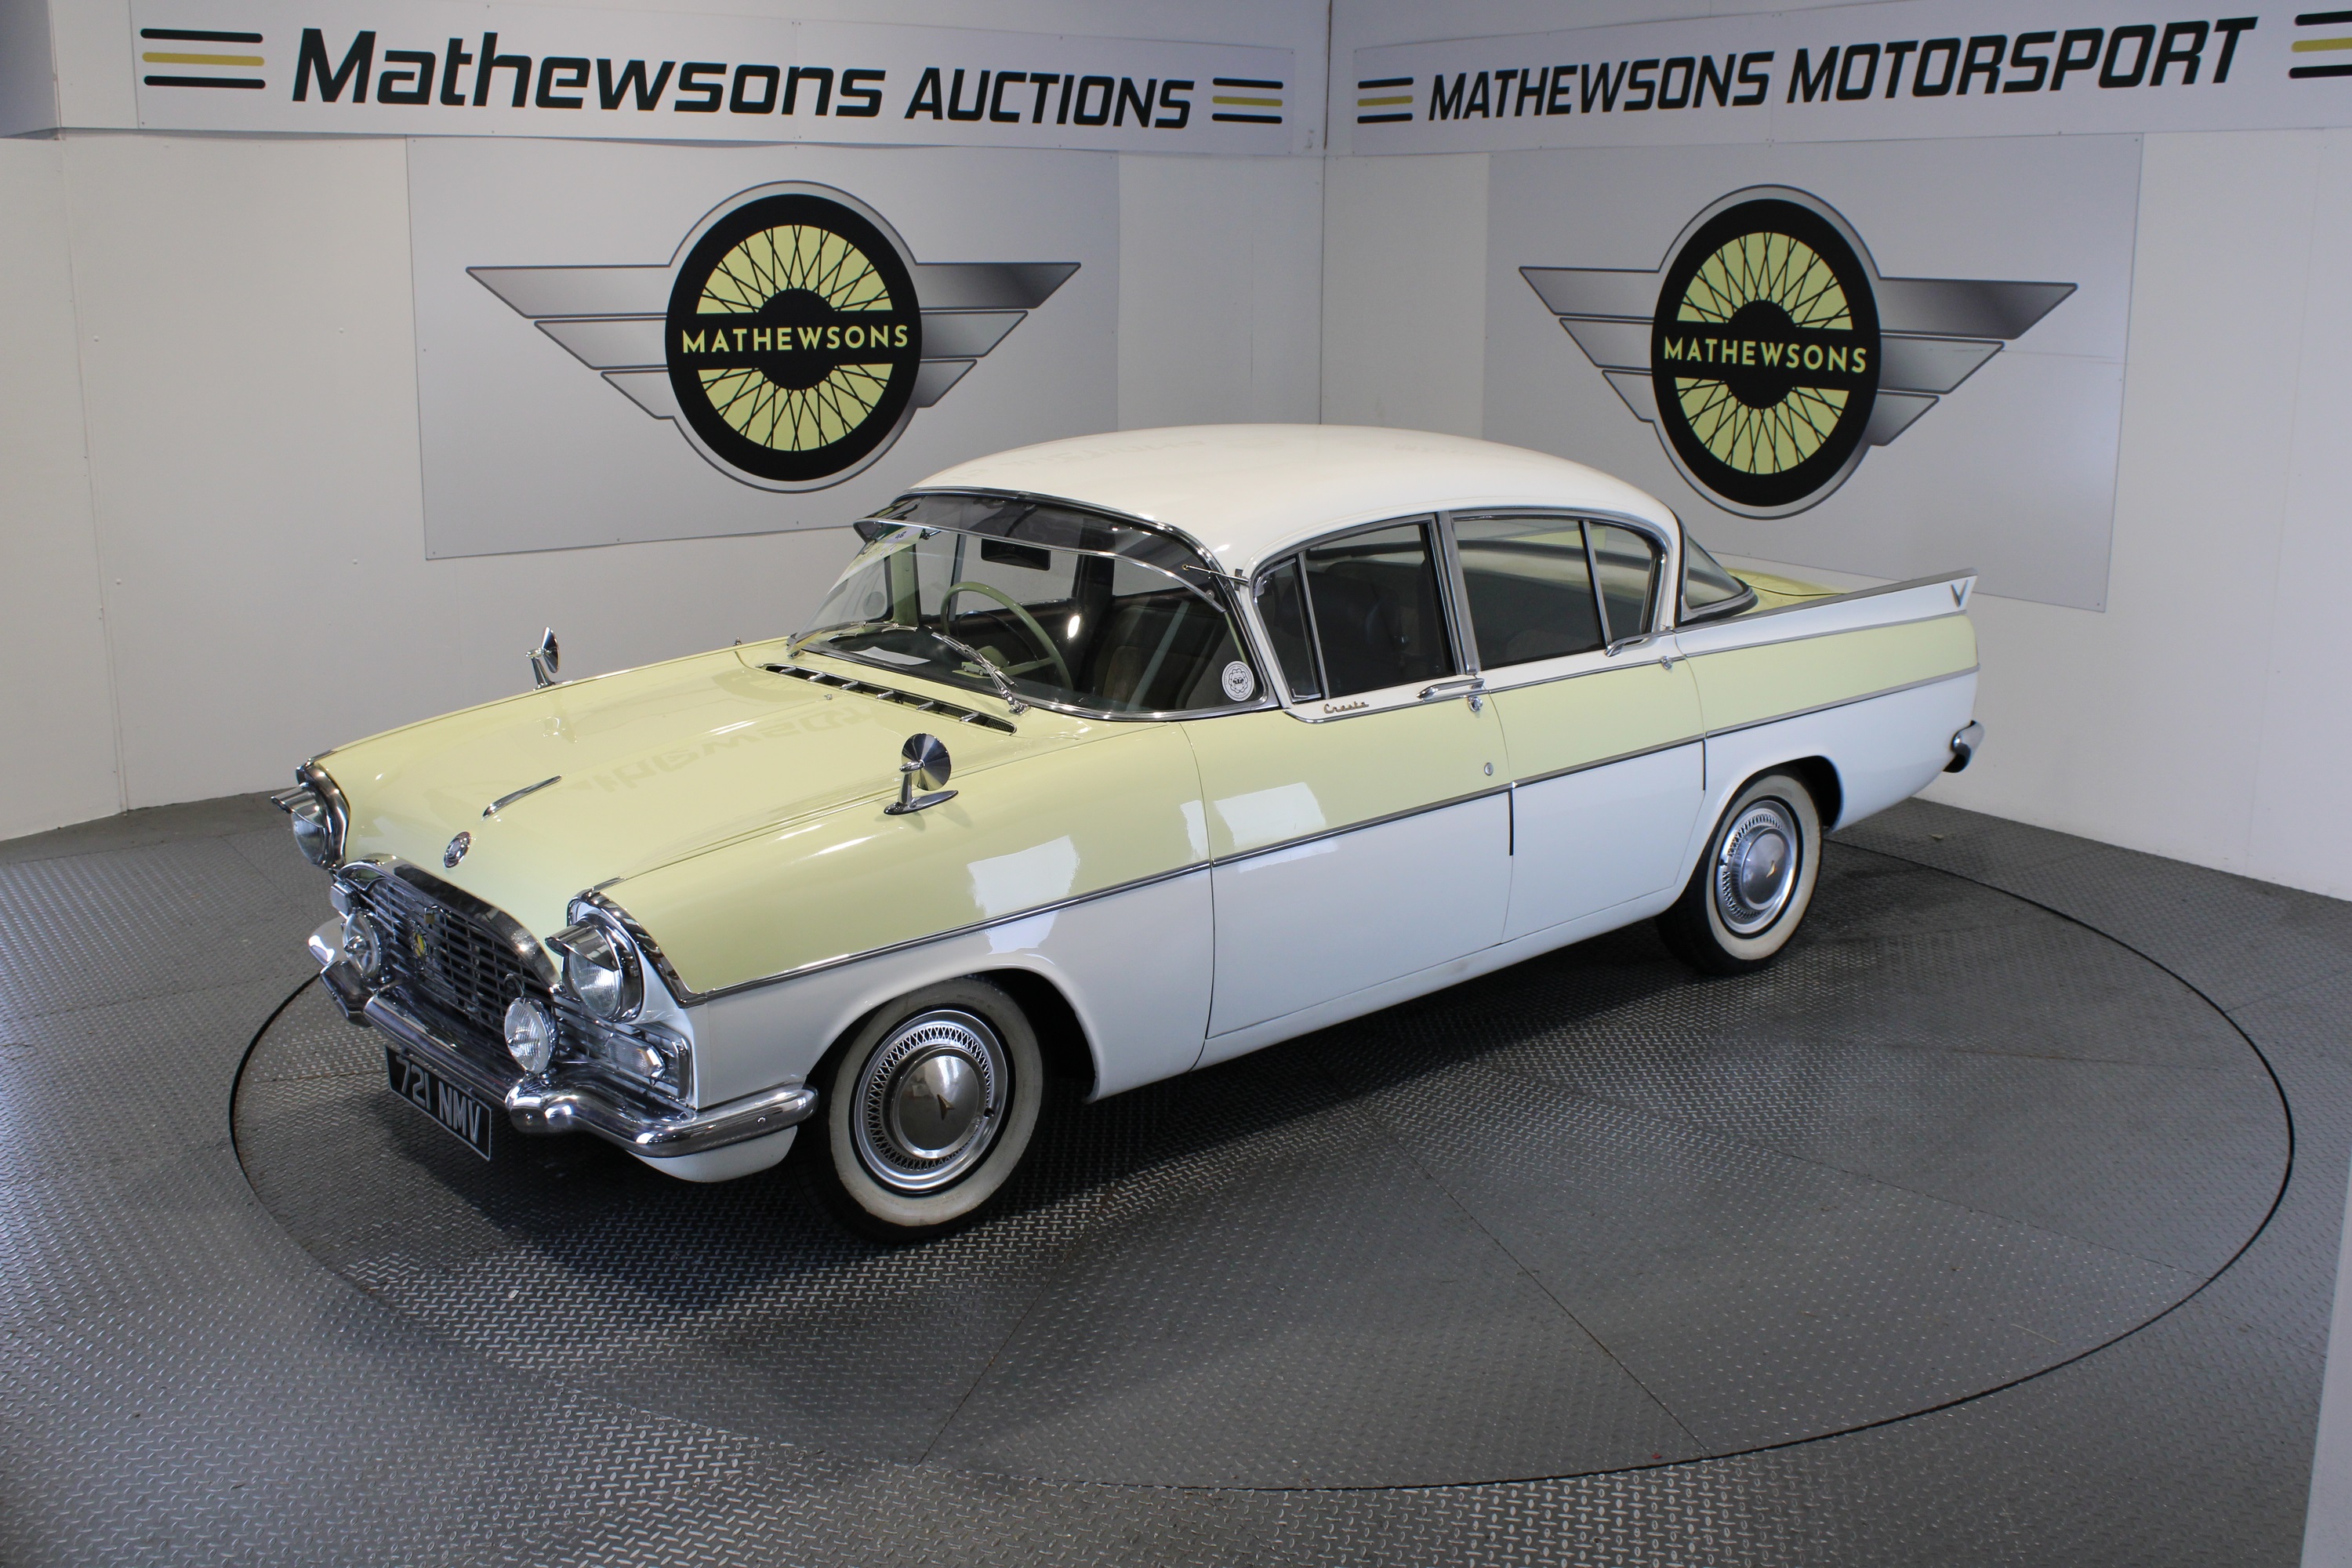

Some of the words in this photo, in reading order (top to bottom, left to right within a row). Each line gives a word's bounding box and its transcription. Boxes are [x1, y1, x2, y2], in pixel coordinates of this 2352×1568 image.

[292, 27, 886, 118] Mathewsons
[904, 67, 1195, 129] AUCTIONS
[1428, 50, 1775, 122] MATHEWSONS
[1786, 16, 2259, 103] MOTORSPORT
[682, 325, 909, 354] MATHEWSONS
[1664, 336, 1867, 373] MATHEWSONS
[1323, 701, 1370, 714] Cresta
[395, 1054, 431, 1111] 721
[438, 1080, 481, 1145] NMV
